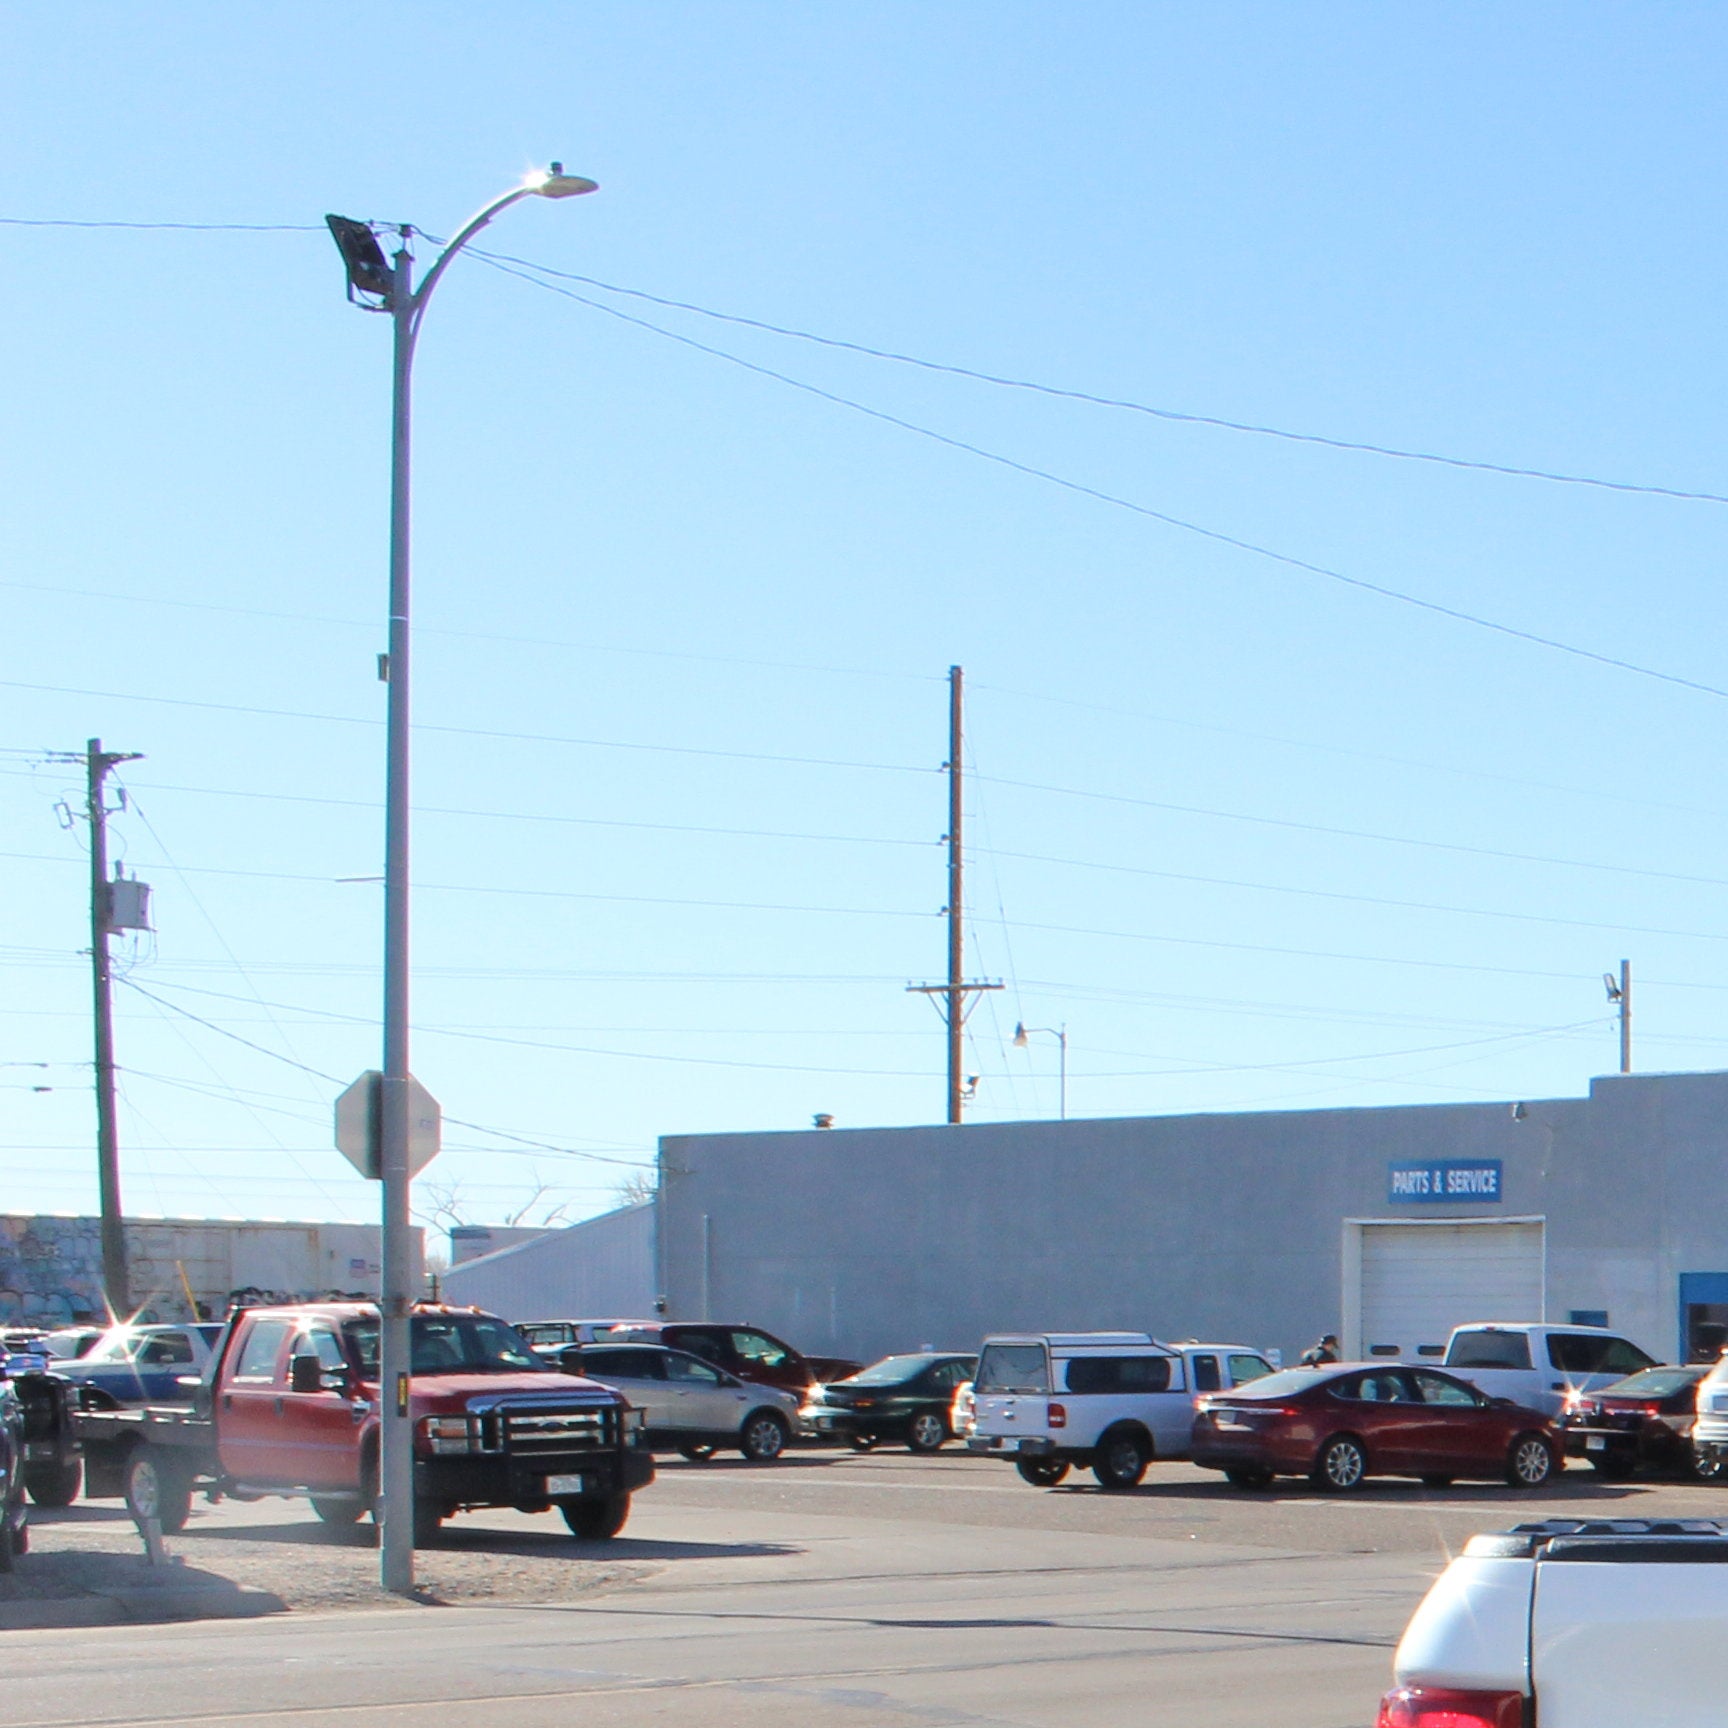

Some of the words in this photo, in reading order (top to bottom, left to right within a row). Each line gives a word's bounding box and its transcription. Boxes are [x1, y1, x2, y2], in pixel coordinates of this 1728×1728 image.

[1392, 1170, 1429, 1195] PARTS
[1433, 1170, 1443, 1194] &
[1447, 1169, 1497, 1193] SERVICE
